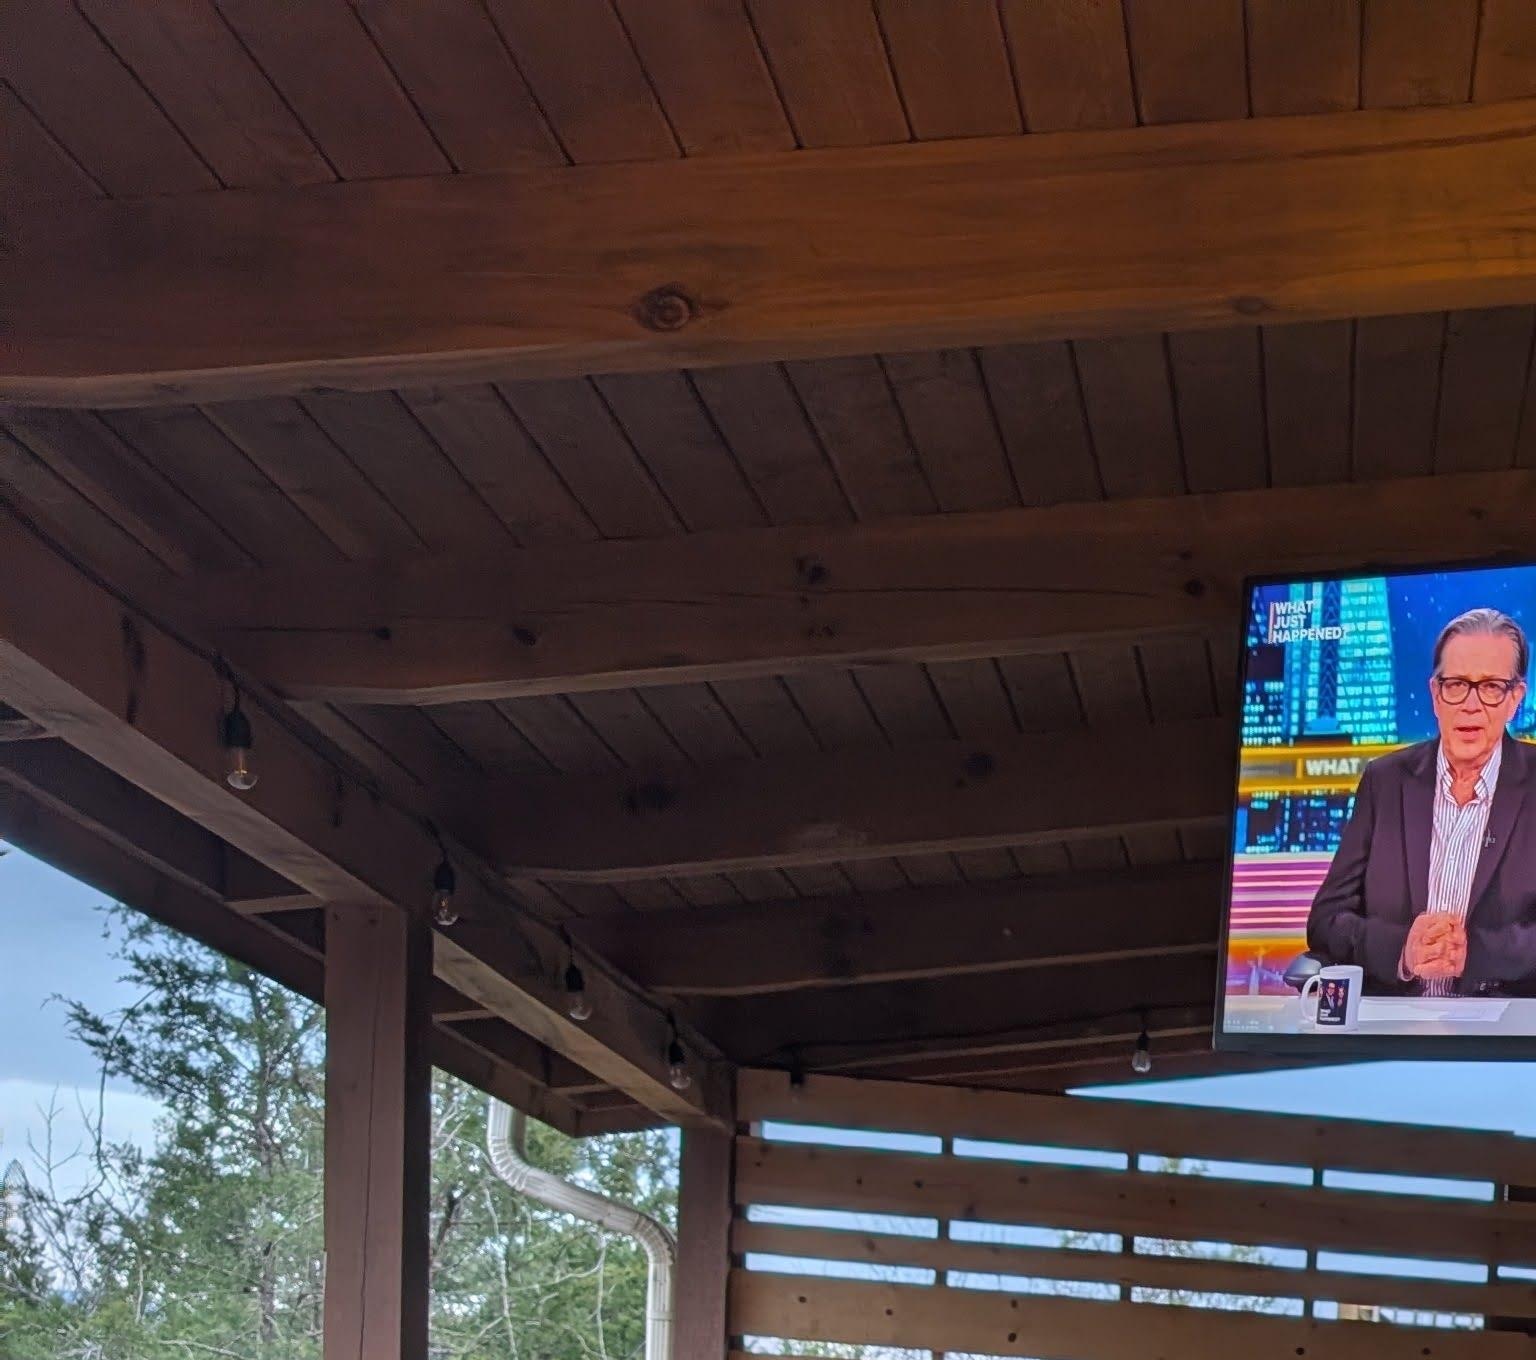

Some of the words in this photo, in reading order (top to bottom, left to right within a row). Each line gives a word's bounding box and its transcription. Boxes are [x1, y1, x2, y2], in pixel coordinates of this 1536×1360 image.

[1274, 601, 1314, 615] WHAT
[1273, 615, 1307, 629] JUST
[1272, 626, 1349, 643] HAPPENED?
[1305, 757, 1361, 776] WHAT
